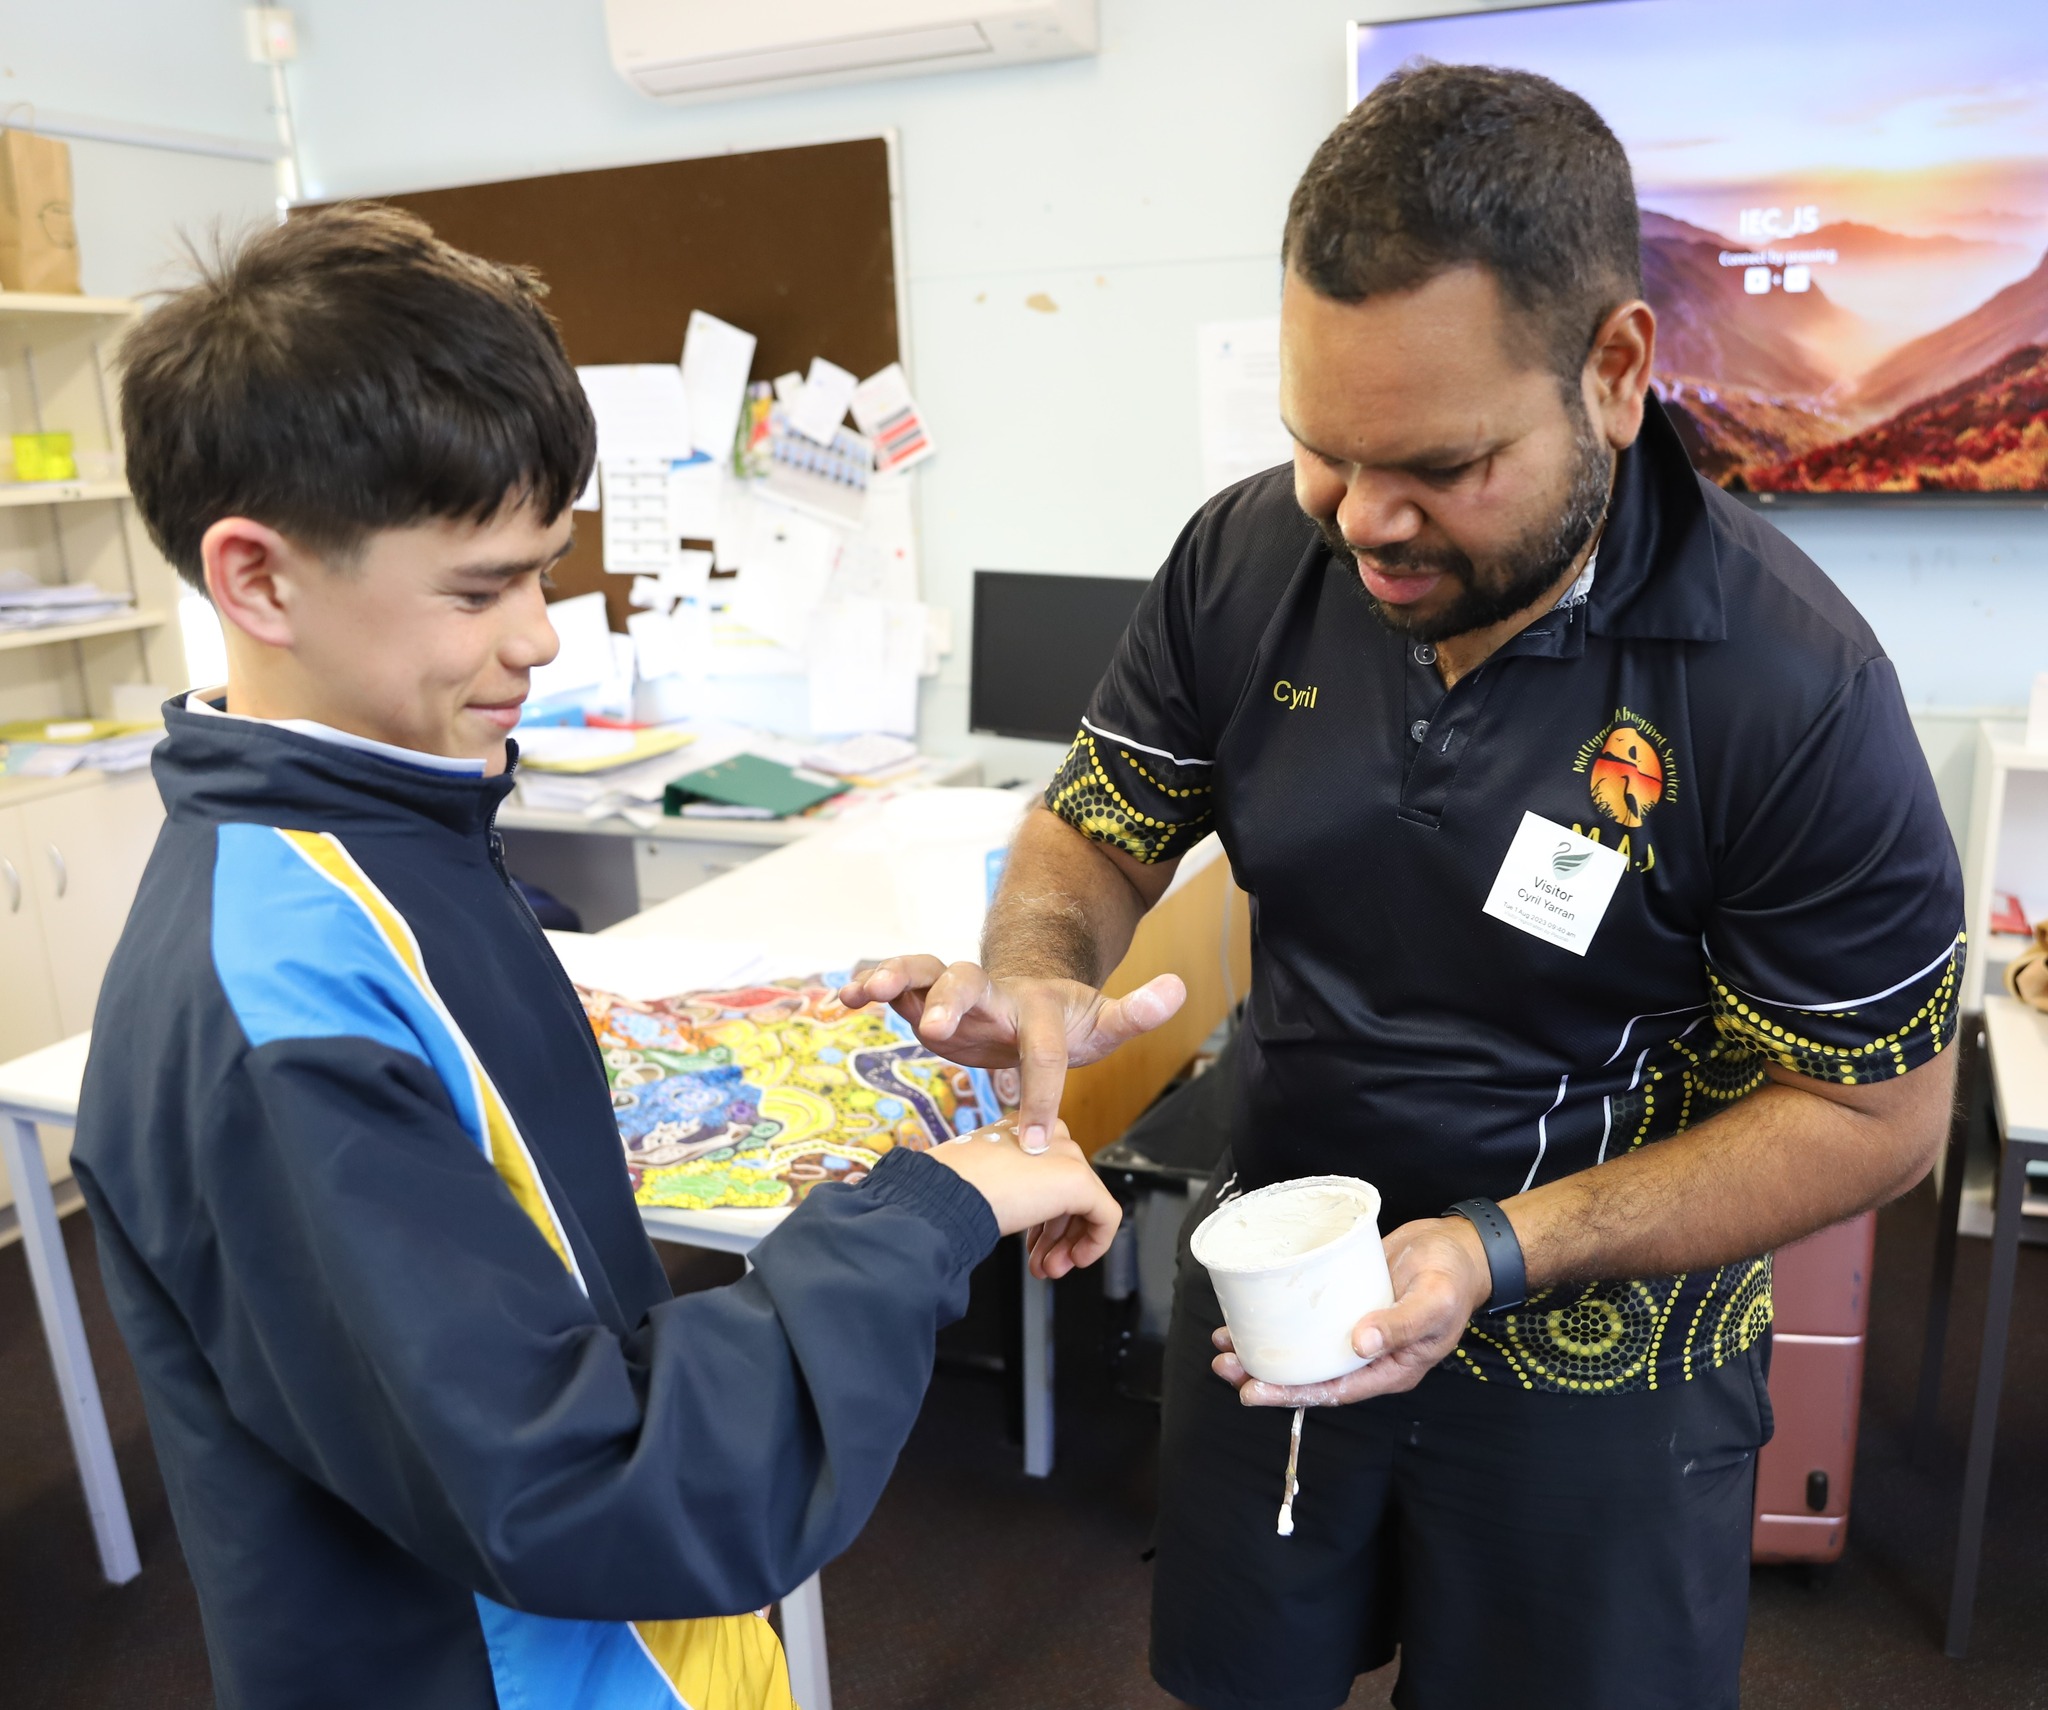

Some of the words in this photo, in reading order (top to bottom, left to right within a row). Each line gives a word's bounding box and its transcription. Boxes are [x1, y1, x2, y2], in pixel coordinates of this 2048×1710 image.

[1273, 680, 1318, 710] Cyril
[1663, 748, 1681, 804] Services
[1518, 888, 1542, 905] Cyril
[1544, 901, 1575, 920] Yarran
[1535, 876, 1573, 902] Visitor
[1504, 902, 1513, 911] Tue
[1519, 910, 1530, 919] Aug
[1531, 914, 1547, 926] 2023
[1566, 931, 1576, 939] am
